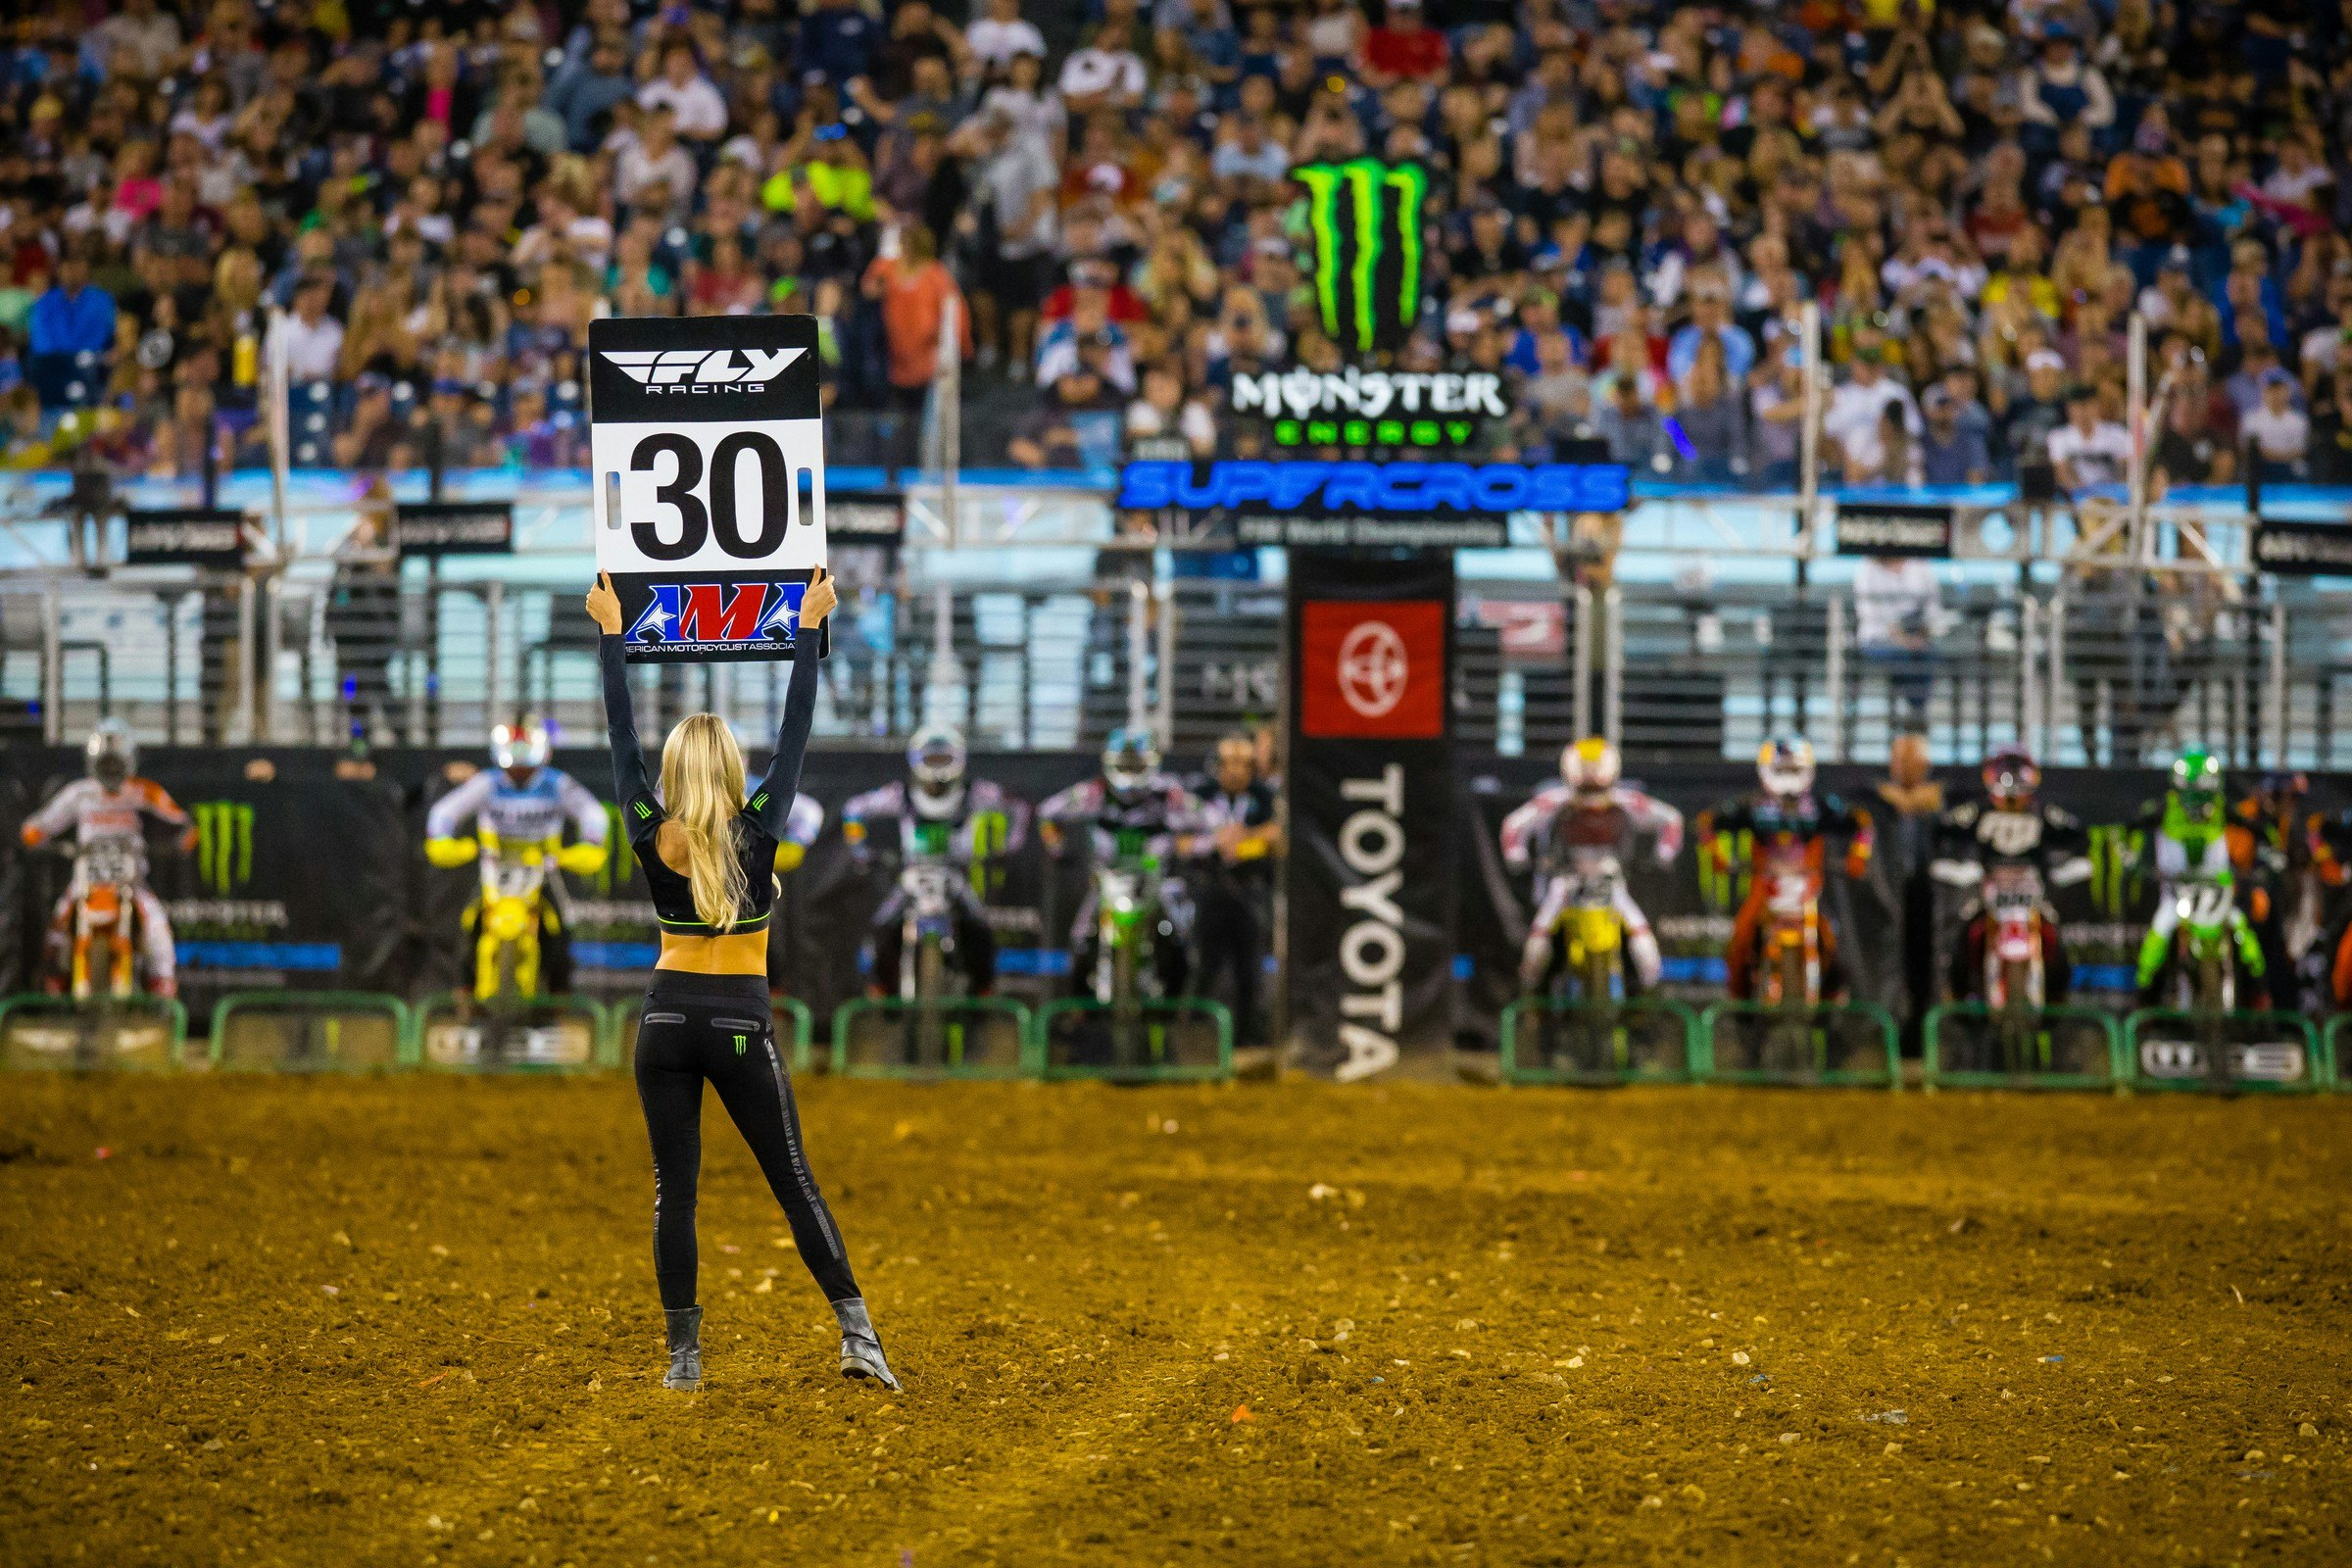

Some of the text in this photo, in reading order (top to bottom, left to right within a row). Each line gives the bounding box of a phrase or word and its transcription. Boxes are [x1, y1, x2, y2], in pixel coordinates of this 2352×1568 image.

[600, 347, 808, 383] FLY
[645, 383, 765, 395] RACING
[1233, 366, 1507, 418] MONSTER
[1274, 419, 1473, 446] ENERGY
[629, 430, 790, 562] 30
[1117, 460, 1630, 512] SUPERCROSS
[625, 582, 808, 643] AMA
[666, 643, 749, 653] MOTORCYCLIST
[748, 642, 796, 652] ASSOCIA
[1335, 762, 1405, 1084] TOYOTA
